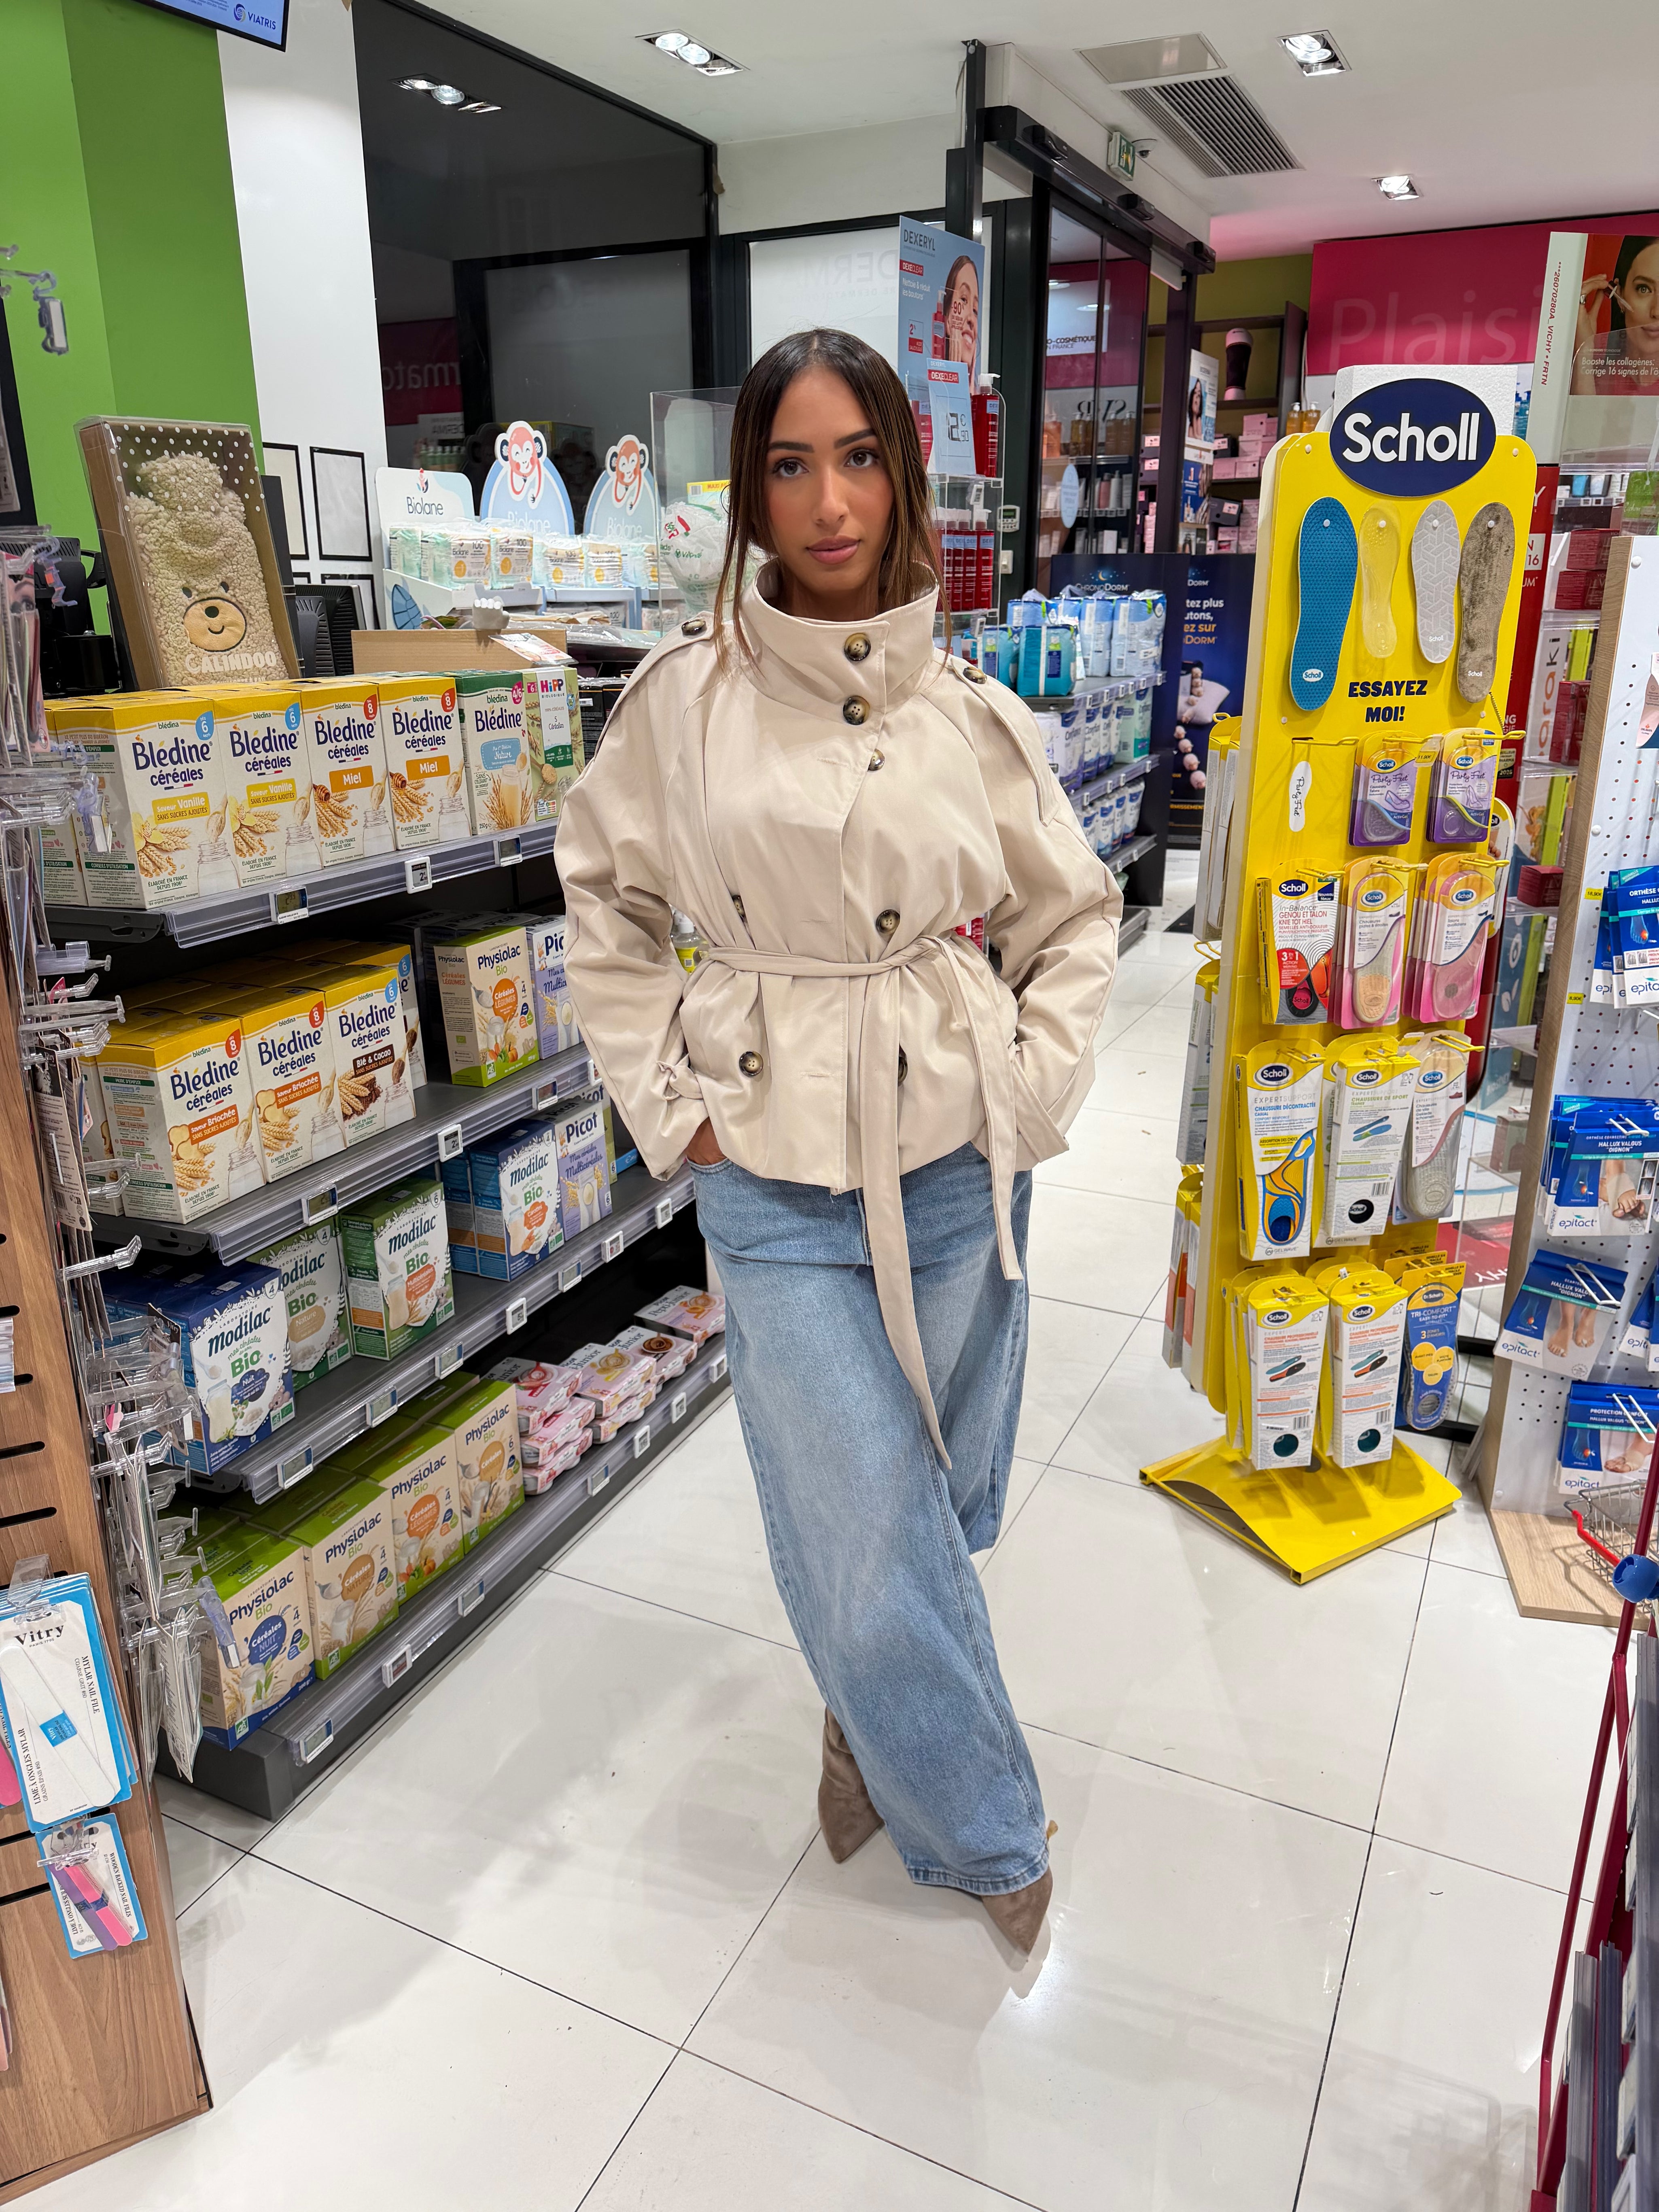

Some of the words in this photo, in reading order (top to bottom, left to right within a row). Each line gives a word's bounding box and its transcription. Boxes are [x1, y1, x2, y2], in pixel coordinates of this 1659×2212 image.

[248, 12, 276, 30] VIATRIS
[904, 229, 936, 251] DEXERYL
[903, 262, 923, 274] DEXECLEAR
[1606, 357, 1615, 365] les
[931, 371, 958, 382] DEXECLEAR
[1541, 361, 1549, 385] FRTN
[1608, 367, 1616, 375] 16
[1618, 367, 1638, 376] signes
[1640, 367, 1649, 376] de
[1343, 412, 1480, 462] Scholl
[406, 497, 443, 515] Biolane
[1528, 554, 1539, 565] 16
[185, 650, 277, 674] CALINDOO
[1348, 680, 1428, 698] ESSAYEZ
[392, 709, 453, 736] Blédine
[1365, 706, 1405, 722] MOI!
[202, 721, 208, 733] 6
[314, 717, 376, 746] Blédine
[229, 726, 299, 758] Blédine
[405, 734, 446, 749] céréales
[132, 737, 212, 771] Blédine
[328, 744, 369, 760] céréales
[244, 755, 291, 772] céréales
[419, 760, 438, 774] Miel
[150, 768, 204, 787] céréales
[343, 772, 361, 785] Miel
[1371, 774, 1392, 785] Party
[1392, 773, 1408, 782] Feet
[1451, 771, 1470, 782] Party
[1470, 770, 1485, 779] Feet
[250, 789, 268, 797] Saveur
[268, 782, 293, 794] Vanille
[1292, 777, 1305, 799] Party
[157, 803, 177, 812] Saveur
[177, 796, 205, 808] Vanille
[261, 795, 277, 804] SUCRES
[157, 813, 168, 821] SANS
[170, 810, 187, 819] SUCRES
[188, 807, 208, 817] AJOUTÉS
[173, 874, 188, 883] FRANCE
[1281, 883, 1306, 892] Scholl
[1629, 887, 1656, 896] ORTHÈSE
[477, 945, 521, 970] Physiolac
[496, 966, 508, 977] Bio
[494, 987, 515, 1000] Céréales
[521, 983, 526, 994] 4
[495, 995, 516, 1009] LÉGUMES
[339, 1004, 396, 1038] Blédine
[230, 1038, 237, 1051] 8
[351, 1025, 391, 1048] céréales
[272, 1052, 316, 1077] céréales
[356, 1058, 367, 1068] Blé
[367, 1056, 373, 1064] &
[374, 1048, 392, 1061] Cacao
[170, 1059, 240, 1100] Blédine
[1263, 1069, 1287, 1078] Scholl
[276, 1088, 292, 1098] Saveur
[292, 1075, 319, 1091] Briochée
[186, 1083, 233, 1112] céréales
[1283, 1102, 1316, 1110] DÉCONTRACTÉE
[190, 1122, 207, 1134] Saveur
[207, 1108, 236, 1127] Briochée
[566, 1111, 598, 1144] Picot
[510, 1153, 549, 1187] modilac
[566, 1152, 603, 1179] Multicéréales
[1559, 1218, 1595, 1228] epitact
[388, 1214, 437, 1255] modilac
[406, 1252, 429, 1275] Bio
[1551, 1281, 1573, 1291] HALLUX
[288, 1292, 317, 1316] Bio
[1411, 1307, 1453, 1318] TRI-COMFORT
[296, 1310, 317, 1327] Nature
[208, 1306, 271, 1357] modilac
[1502, 1342, 1540, 1359] epitact
[231, 1350, 261, 1379] Bio
[243, 1374, 255, 1386] Nuit
[1590, 1408, 1623, 1416] PROTECTION
[465, 1403, 510, 1446] Physiolac
[391, 1454, 447, 1500] Physiolac
[1565, 1479, 1600, 1489] epitact
[407, 1499, 437, 1523] Céréales
[325, 1512, 383, 1564] Physiolac
[344, 1560, 372, 1588] Céréales
[346, 1573, 371, 1593] NATURE
[229, 1571, 295, 1625] Physiolac
[255, 1603, 273, 1621] Bio
[293, 1610, 301, 1620] 4
[15, 1625, 64, 1647] Vitry
[252, 1622, 282, 1647] Céréales
[259, 1634, 277, 1653] NUIT
[82, 1656, 92, 1681] MYLAR
[87, 1681, 97, 1700] NAIL
[91, 1699, 100, 1715] FILE
[17, 1727, 30, 1754] MYLAR
[24, 1753, 35, 1781] ONGLES
[31, 1787, 41, 1805] LIME
[109, 1852, 119, 1874] WOODEN
[115, 1873, 123, 1893] BACKED
